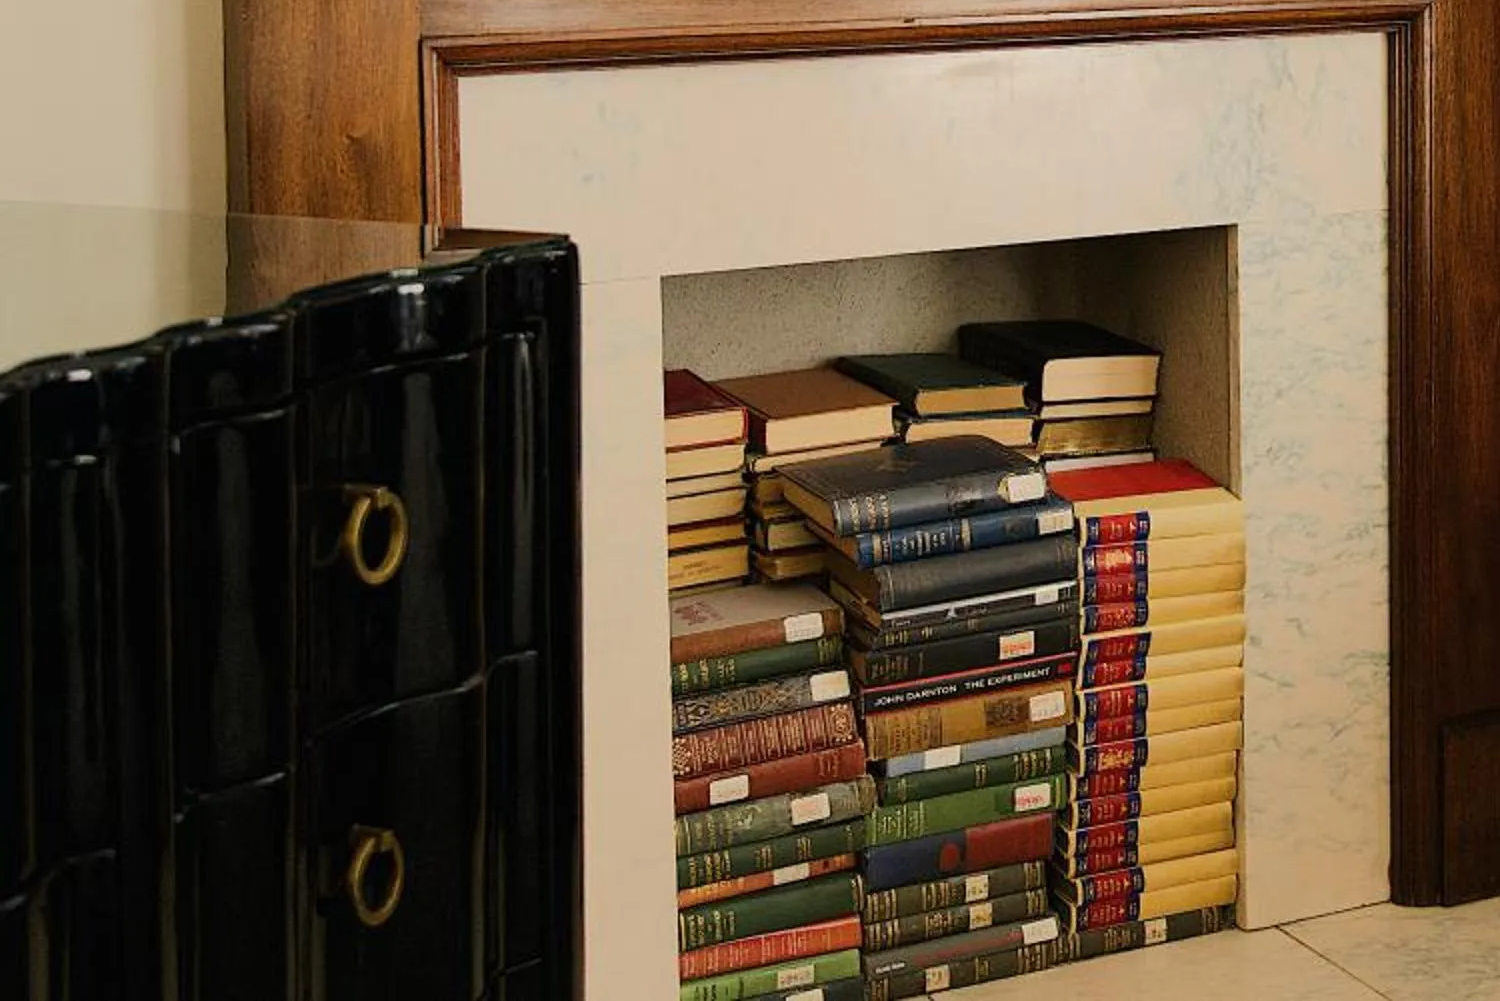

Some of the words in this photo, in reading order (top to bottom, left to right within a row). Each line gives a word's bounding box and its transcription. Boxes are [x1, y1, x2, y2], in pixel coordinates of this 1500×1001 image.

[873, 694, 905, 706] JOHN
[906, 684, 957, 701] DARNTON
[964, 678, 985, 690] THE
[988, 667, 1051, 686] EXPERIMENT
